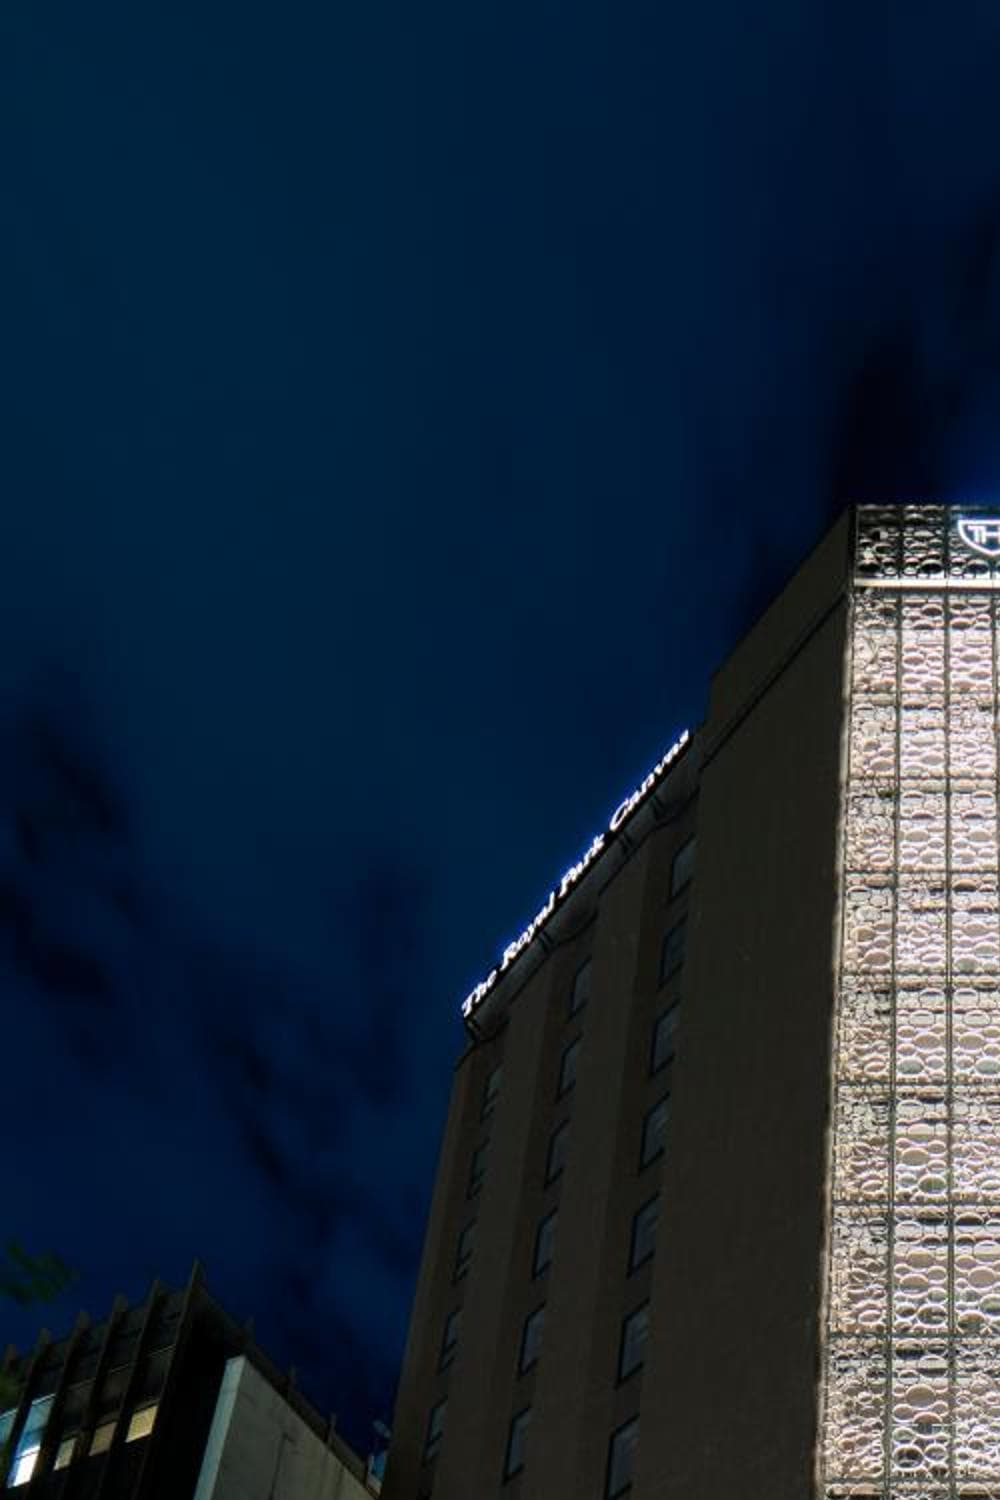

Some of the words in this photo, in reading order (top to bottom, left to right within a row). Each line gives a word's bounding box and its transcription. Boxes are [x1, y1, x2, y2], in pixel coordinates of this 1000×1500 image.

[461, 970, 498, 1018] The
[500, 891, 556, 972] Royal
[558, 833, 605, 899] Park
[610, 729, 690, 832] Canvas
